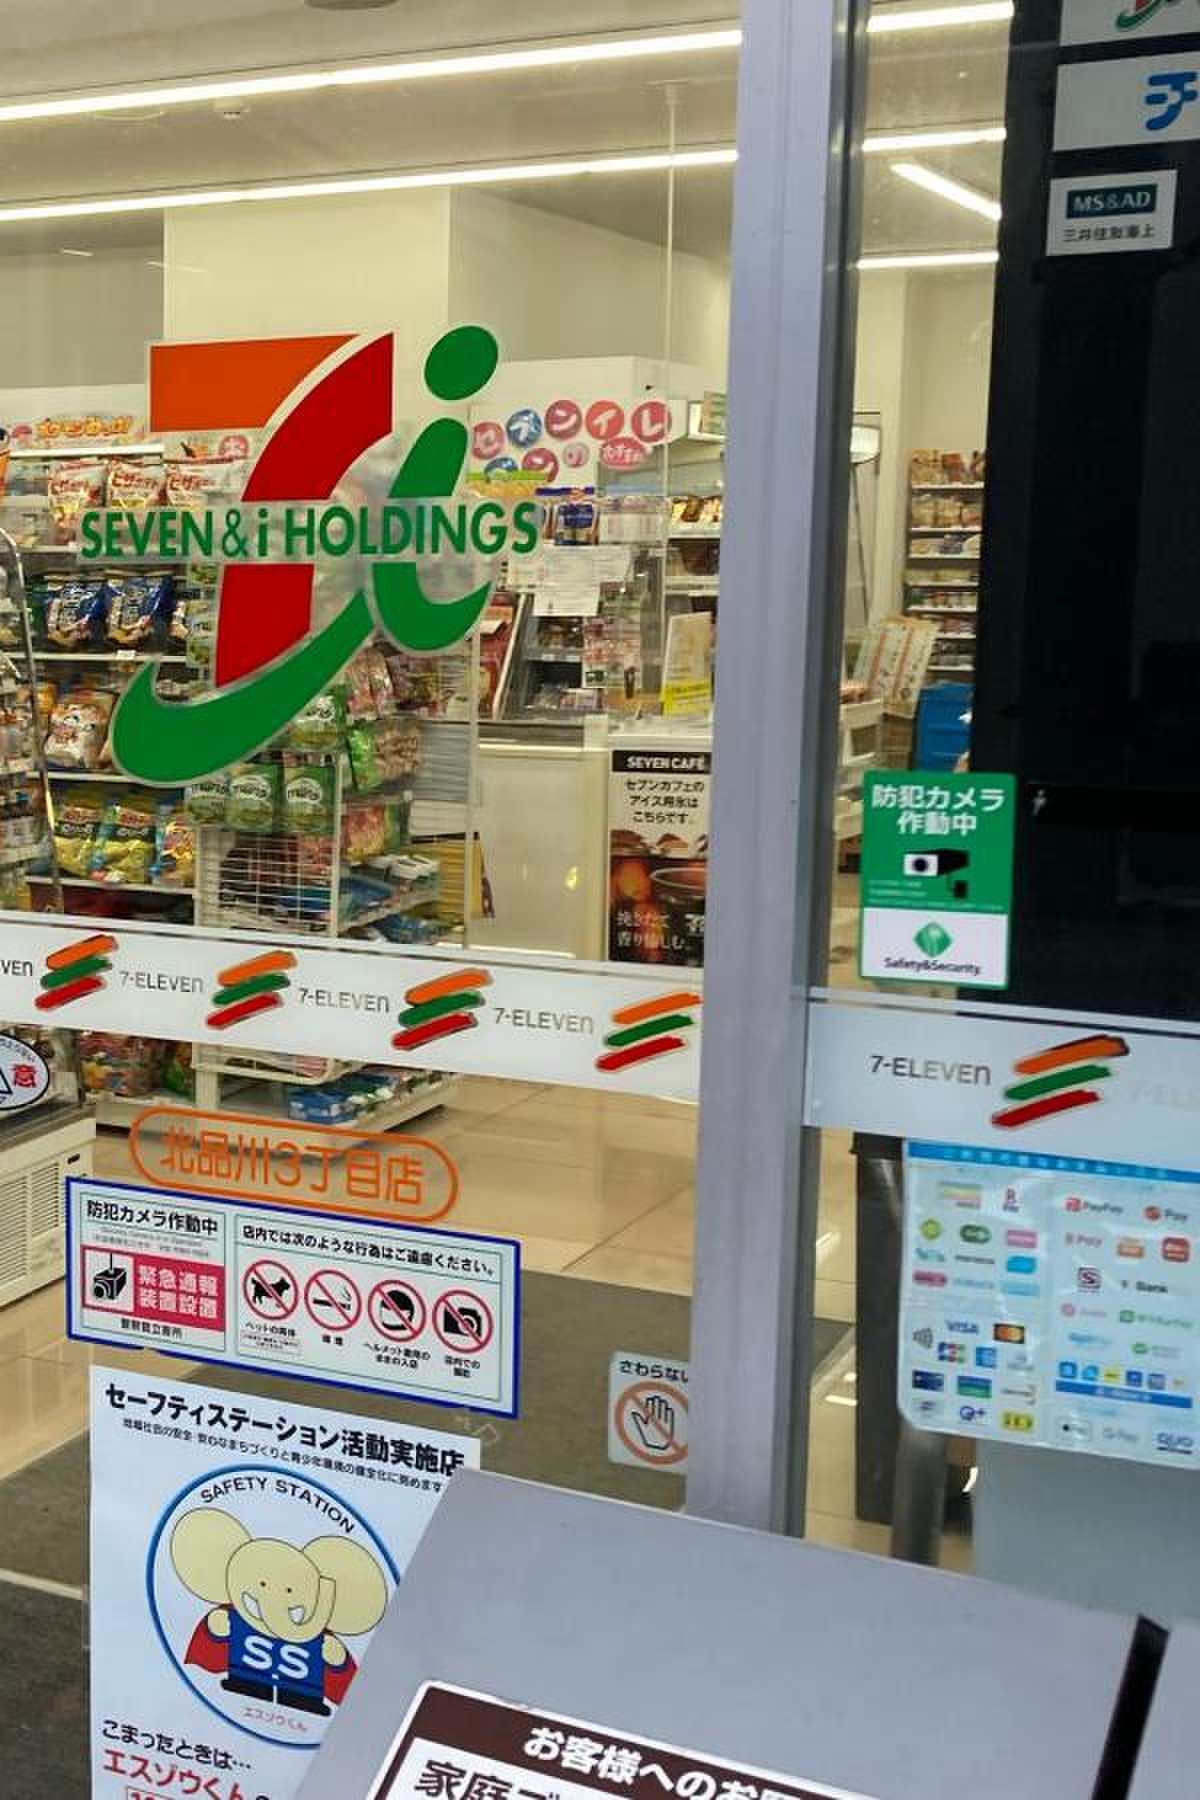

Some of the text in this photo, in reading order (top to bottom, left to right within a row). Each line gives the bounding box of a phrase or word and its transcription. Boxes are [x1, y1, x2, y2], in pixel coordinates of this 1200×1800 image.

[1073, 191, 1151, 212] MS&AD
[284, 502, 538, 557] HOLDINGS
[627, 756, 669, 769] SEVEN
[626, 779, 704, 792] セブンカフェの
[872, 785, 1005, 811] 防犯カメラ
[898, 812, 977, 837] 作動中
[160, 1124, 425, 1206] 北品川3丁目店
[87, 1199, 219, 1236] 防犯カメラ作動中
[243, 1224, 495, 1277] 店内では次のような行為はご遠慮ください。
[105, 1382, 465, 1477] セーフティステーション活動実施店
[200, 1477, 356, 1534] SAFETY STATION
